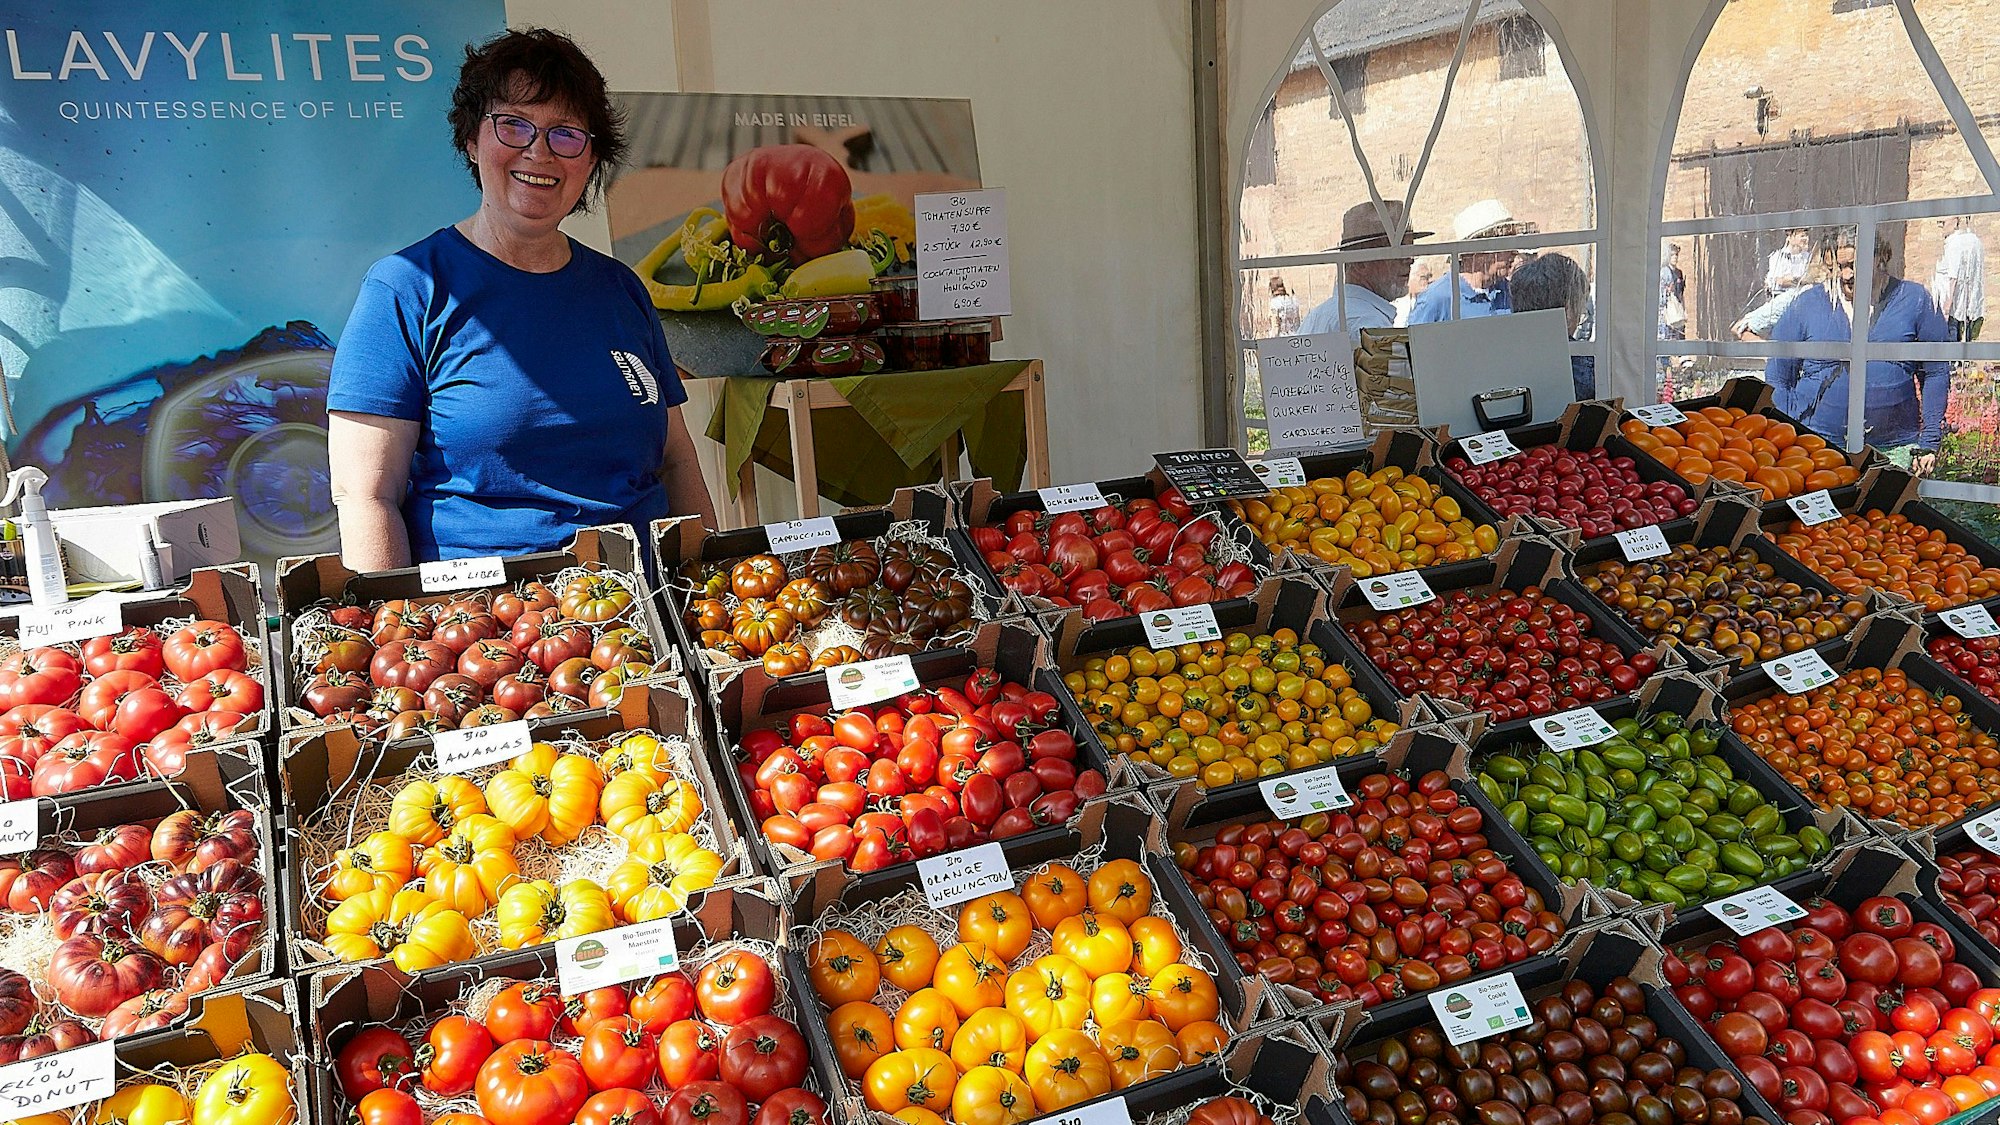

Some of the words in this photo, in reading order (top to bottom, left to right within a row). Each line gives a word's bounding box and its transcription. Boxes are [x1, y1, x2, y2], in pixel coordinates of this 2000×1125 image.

[6, 29, 434, 82] LAVYLITES
[59, 101, 287, 124] QUINTESSENCE
[299, 101, 335, 119] OF
[349, 102, 404, 119] LIFE
[734, 112, 785, 127] MADE
[789, 113, 807, 127] IN
[812, 113, 856, 127] EIFEL
[950, 197, 966, 207] BIO
[923, 243, 929, 252] 2
[932, 238, 961, 252] STÜCK
[922, 265, 1000, 280] COCKTAILTOMATEN
[943, 280, 988, 293] HONIGSUD
[1288, 338, 1312, 348] BIO
[1265, 350, 1327, 368] TOMATEN
[1269, 384, 1325, 399] AUBERGINE
[1272, 403, 1318, 418] GURKEN
[1281, 427, 1336, 439] SARDISCHES
[1341, 425, 1360, 434] BROT
[1170, 452, 1230, 464] TOMATEN
[771, 530, 831, 545] CAPPUCCINO
[1624, 534, 1650, 546] INDIGO
[423, 574, 458, 585] CUBA
[467, 569, 501, 580] LIBRE
[26, 624, 53, 637] FUJI
[68, 615, 106, 629] PINK
[463, 730, 488, 742] BIO
[445, 738, 523, 765] ANANAS
[0, 830, 34, 843] AUTY
[945, 856, 963, 867] BIO
[927, 861, 983, 886] ORANGE
[931, 870, 1008, 903] WELLINGTON
[622, 928, 662, 941] Bio-Tomate
[628, 938, 659, 949] Maestria
[1487, 990, 1507, 1001] Cookie
[33, 1059, 58, 1073] BIO
[0, 1067, 74, 1094] ELLOW
[11, 1077, 104, 1108] DONUT
